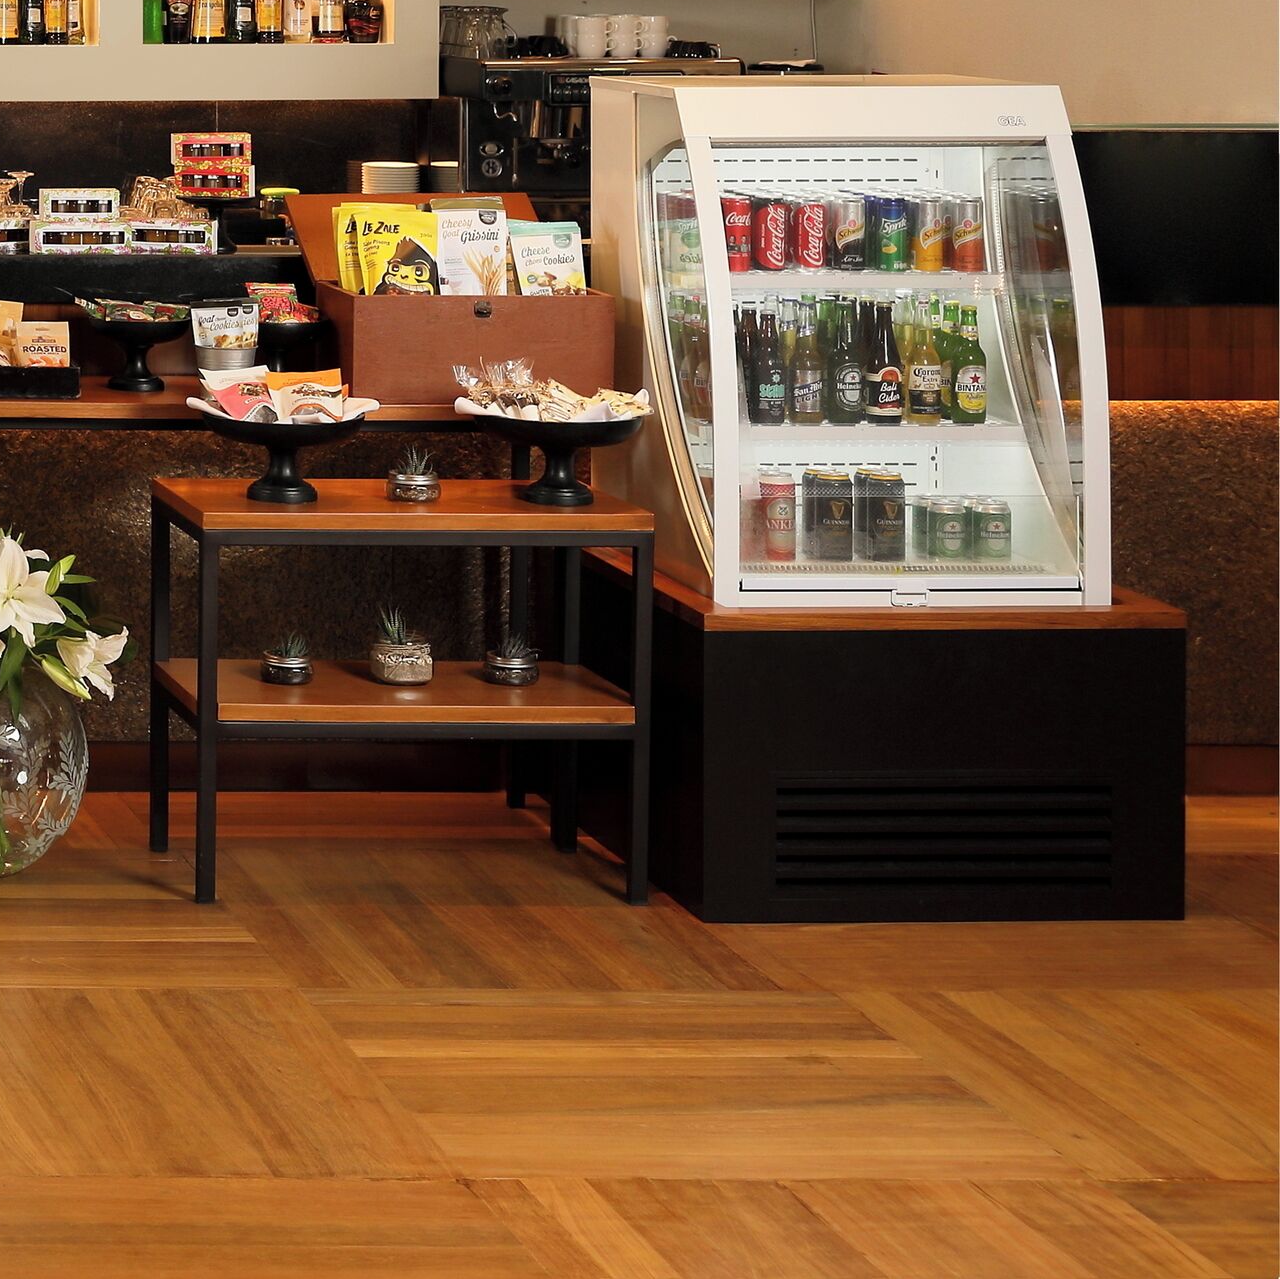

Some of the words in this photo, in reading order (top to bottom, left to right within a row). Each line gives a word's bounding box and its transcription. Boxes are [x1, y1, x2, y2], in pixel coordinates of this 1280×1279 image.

[461, 228, 500, 244] Grissini
[521, 246, 550, 259] Cheese
[543, 254, 575, 265] Cookies
[22, 345, 67, 353] ROASTED
[880, 382, 897, 392] Bali
[879, 392, 900, 403] Cider
